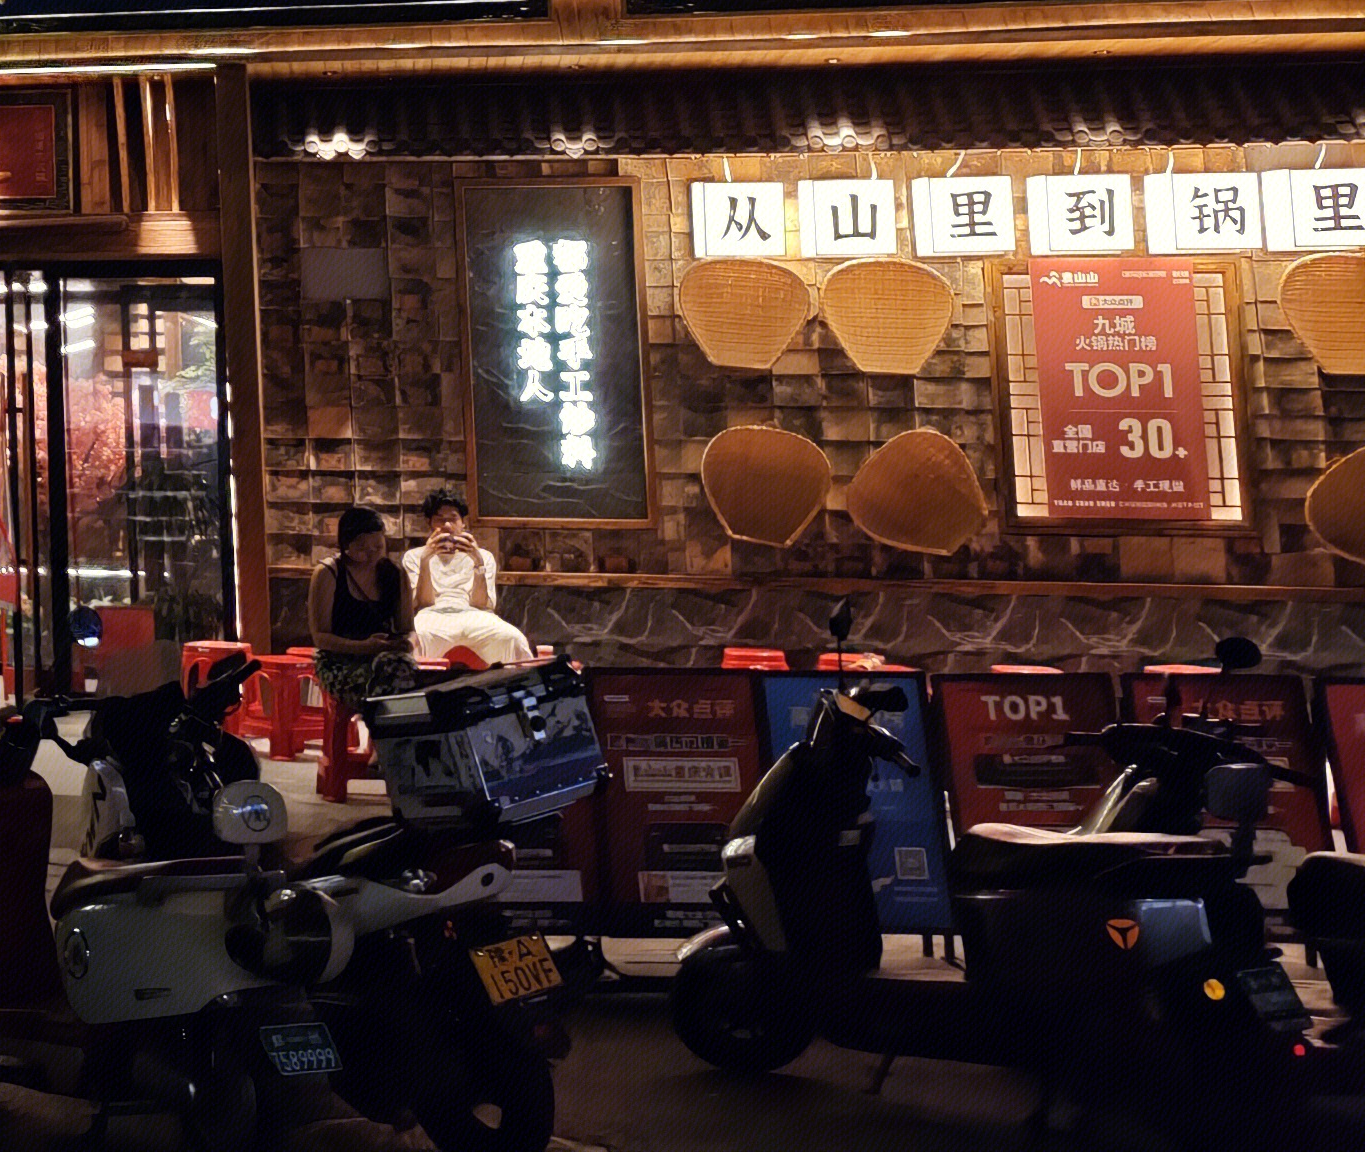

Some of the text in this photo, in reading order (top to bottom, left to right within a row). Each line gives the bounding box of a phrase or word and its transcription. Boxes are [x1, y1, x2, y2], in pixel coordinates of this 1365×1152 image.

[721, 183, 1365, 242] 从山里到锅里
[1093, 315, 1135, 334] 九城
[1075, 336, 1157, 351] 火锅热门榜
[1065, 362, 1173, 397] TOP1
[980, 695, 1071, 721] TOP1
